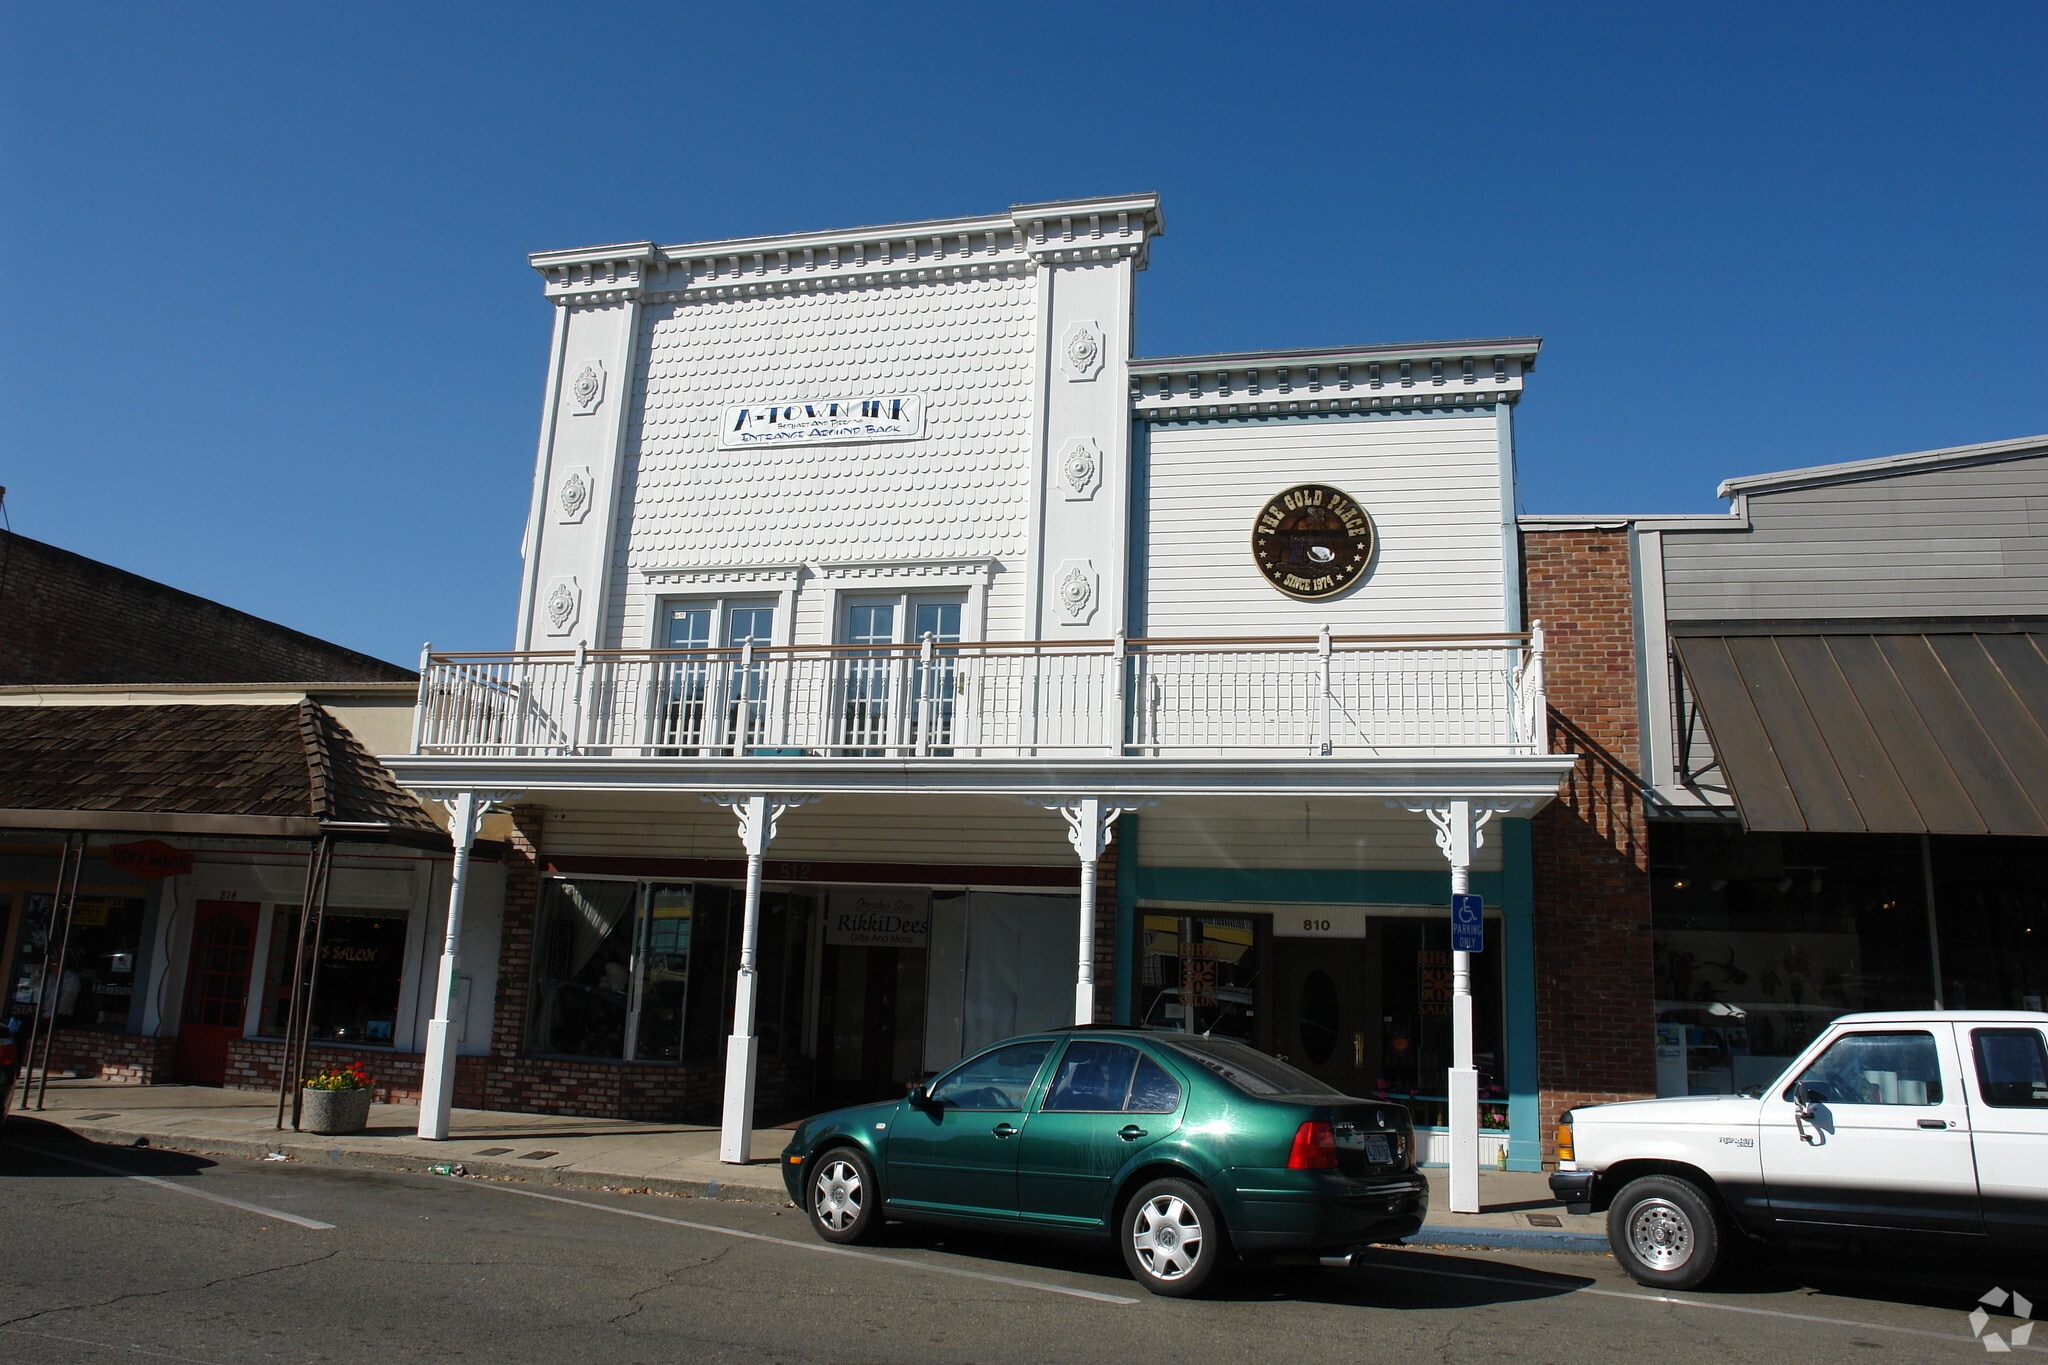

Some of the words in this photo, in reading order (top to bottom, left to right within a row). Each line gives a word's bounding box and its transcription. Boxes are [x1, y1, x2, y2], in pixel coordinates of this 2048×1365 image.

[733, 402, 850, 432] A-TOWN
[861, 398, 910, 422] INK
[741, 430, 804, 442] ENTRANCE
[808, 428, 861, 438] AROUND
[865, 424, 901, 434] BACK
[1257, 505, 1286, 535] THE
[1283, 489, 1323, 511] GOLD
[1327, 494, 1366, 538] PLACE
[1283, 573, 1311, 591] SINCE
[1313, 575, 1335, 591] 1974
[779, 863, 812, 880] 812
[219, 890, 238, 900] 814
[837, 912, 928, 934] RikkiDees
[1303, 919, 1331, 931] 810
[1453, 923, 1482, 936] PARKING
[850, 933, 869, 942] Gifts
[871, 933, 889, 943] And
[890, 934, 913, 944] More
[1459, 938, 1476, 949] ONLY
[1179, 943, 1219, 957] BIBA
[1178, 996, 1219, 1007] SALON
[1417, 1005, 1453, 1016] SALO
